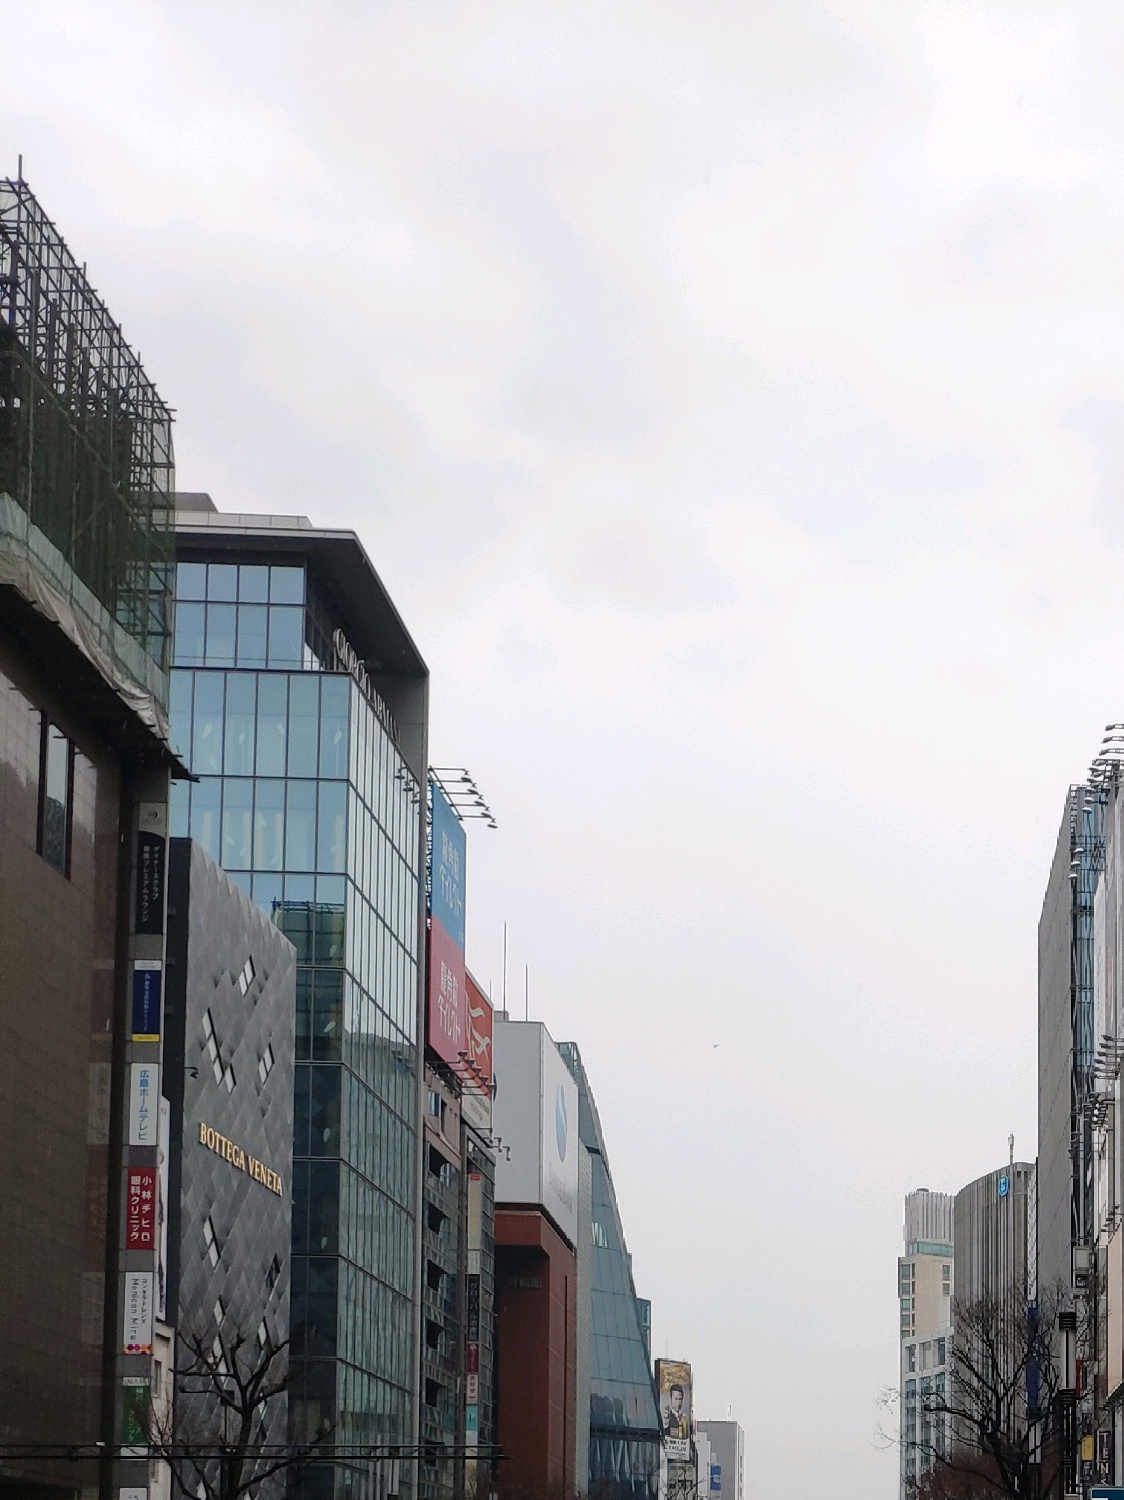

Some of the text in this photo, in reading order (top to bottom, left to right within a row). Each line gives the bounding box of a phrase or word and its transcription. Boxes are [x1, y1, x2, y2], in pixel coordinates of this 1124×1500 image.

[138, 1070, 150, 1141] 広島ホームテレビ
[199, 1122, 283, 1196] BOTTEGA VENETA
[130, 1175, 141, 1242] 眼科クリニック
[141, 1175, 152, 1242] 小林チヒロ
